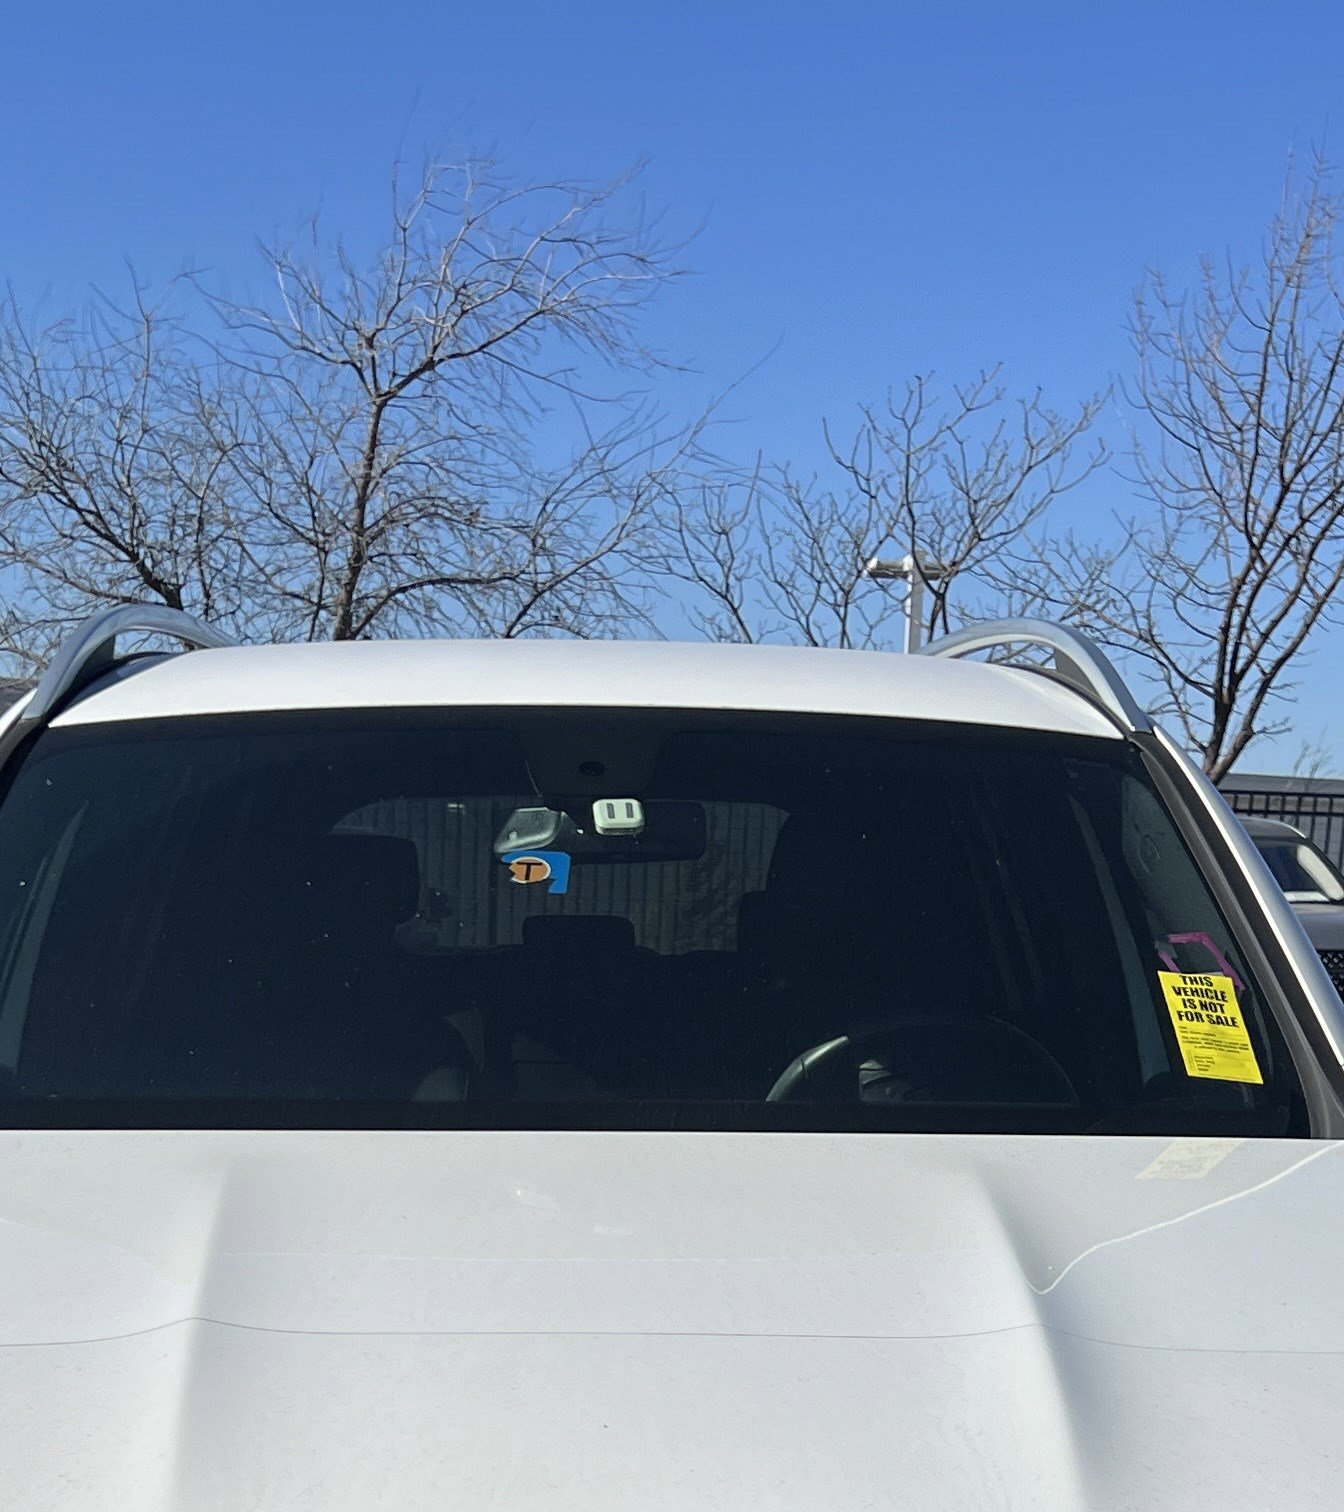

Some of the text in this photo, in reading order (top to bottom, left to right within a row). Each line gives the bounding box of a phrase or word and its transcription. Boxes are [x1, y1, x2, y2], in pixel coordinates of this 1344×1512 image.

[1180, 975, 1213, 986] THIS
[1172, 986, 1228, 1002] VEHICLE
[1182, 998, 1225, 1014] IS NOT
[1177, 1011, 1239, 1027] FOR SALE
